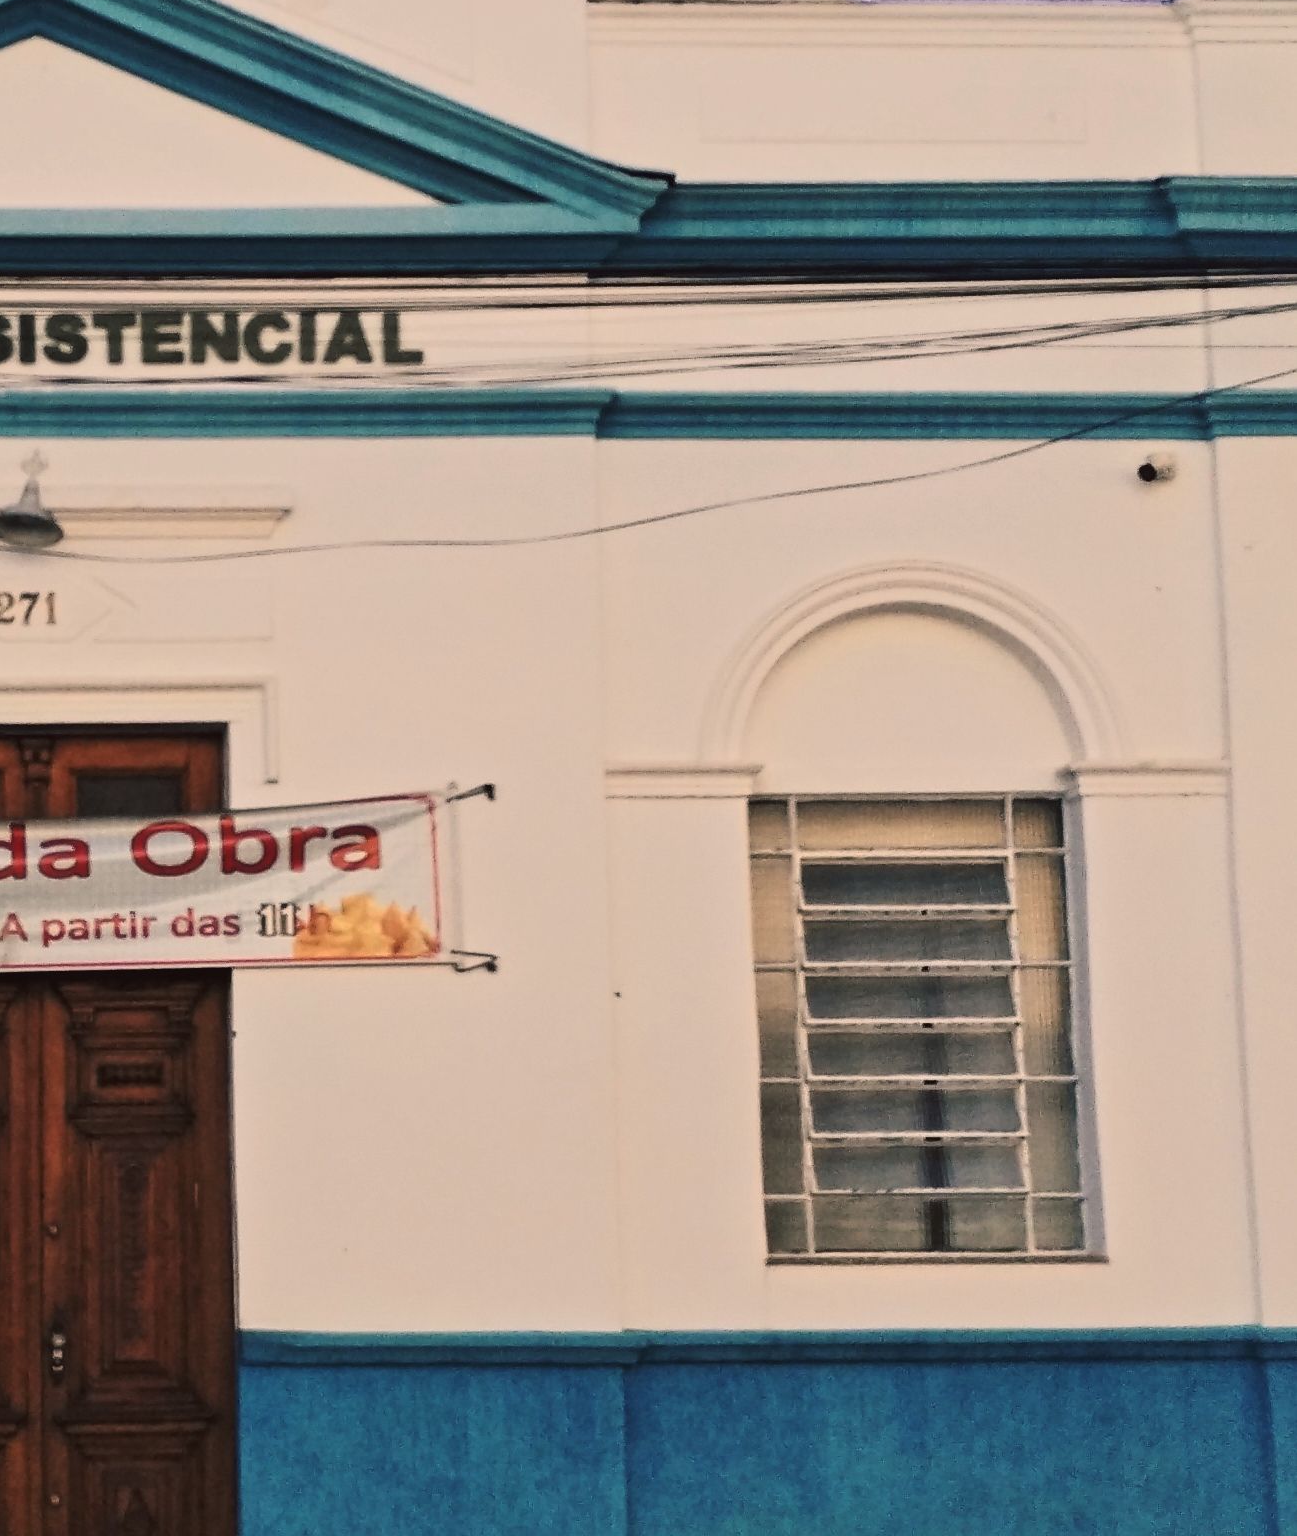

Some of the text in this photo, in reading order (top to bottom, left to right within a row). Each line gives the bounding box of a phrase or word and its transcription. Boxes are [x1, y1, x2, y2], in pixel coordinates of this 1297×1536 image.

[131, 815, 382, 877] Obra
[41, 910, 157, 947] partir
[171, 908, 241, 938] das
